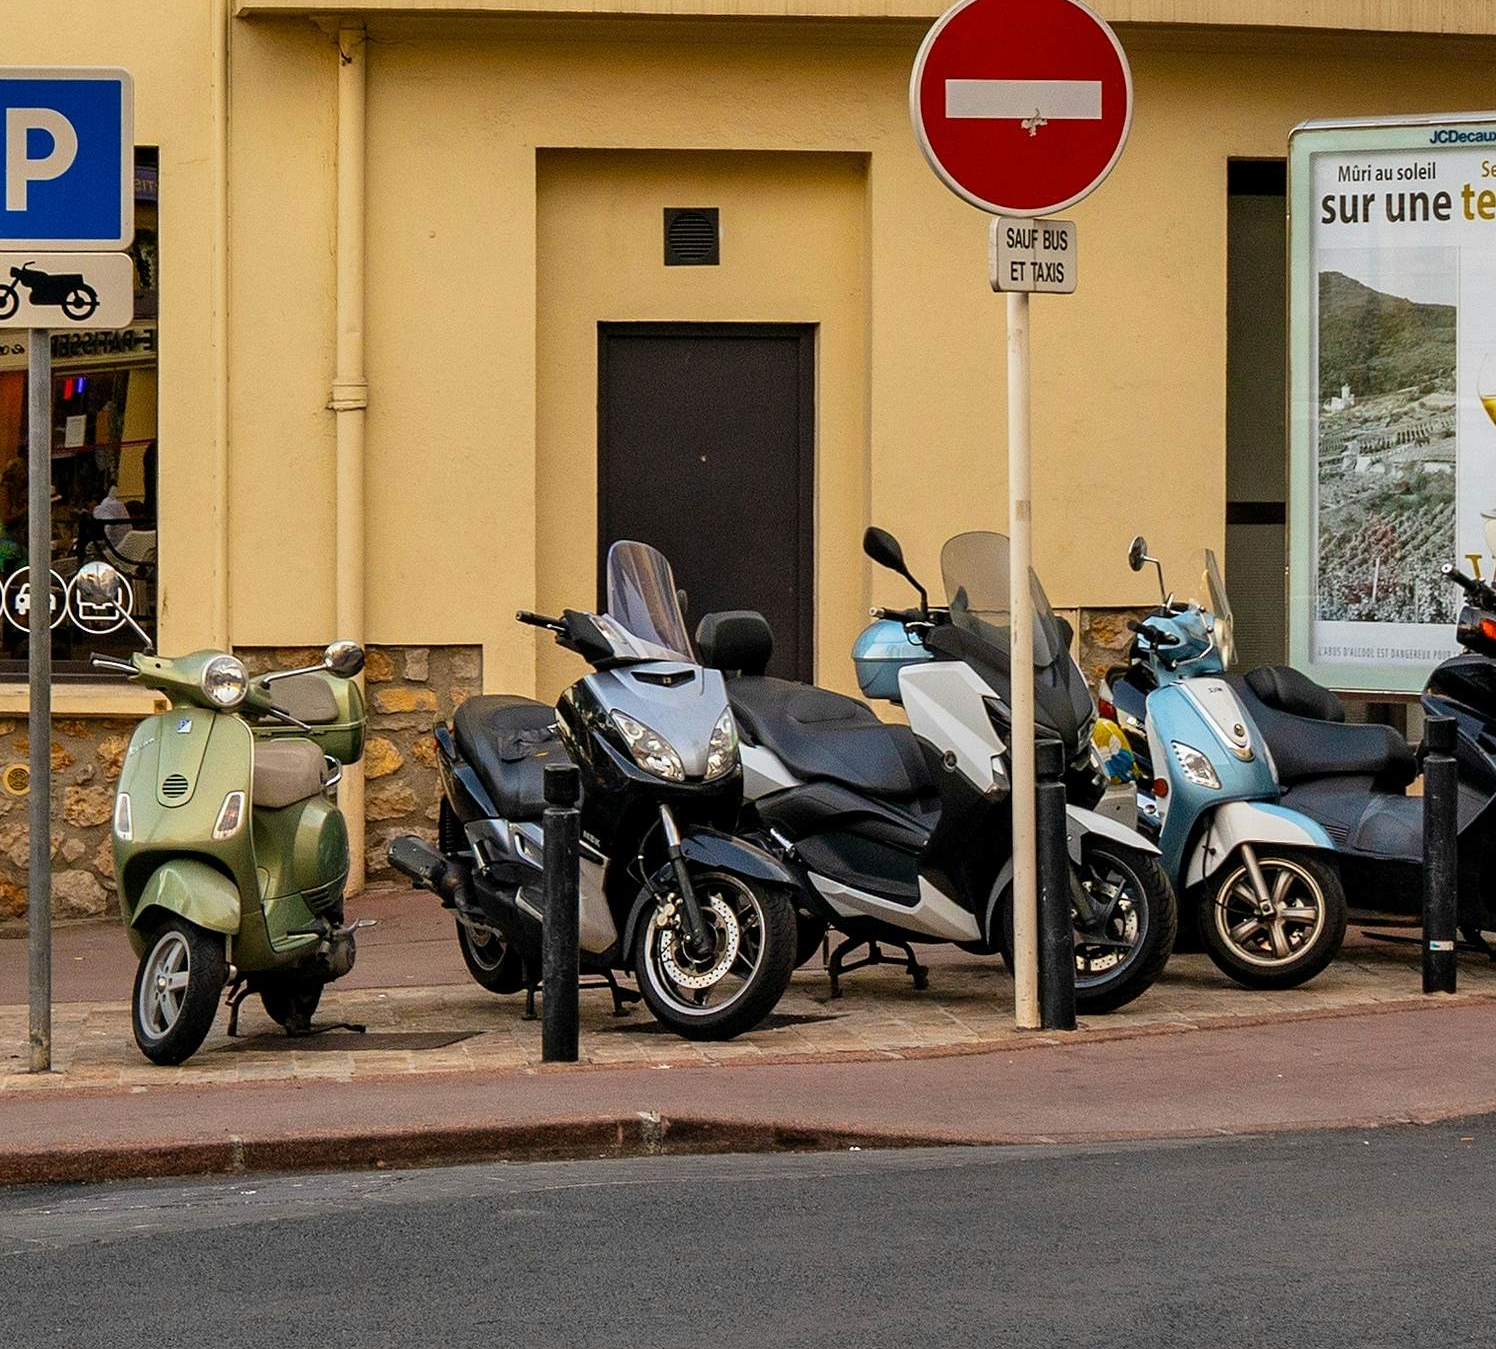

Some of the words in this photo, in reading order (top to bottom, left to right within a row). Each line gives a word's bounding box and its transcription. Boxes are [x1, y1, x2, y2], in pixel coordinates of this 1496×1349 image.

[5, 107, 78, 212] P
[1338, 164, 1371, 183] Mûri
[1375, 167, 1393, 181] au
[1397, 162, 1436, 181] soleil
[1321, 183, 1375, 224] sur
[1385, 180, 1452, 222] une
[1006, 228, 1038, 249] SAUF
[1043, 229, 1068, 251] BUS
[1010, 261, 1025, 282] ET
[1030, 261, 1065, 284] TAXIS
[1376, 647, 1389, 658] EST
[1391, 648, 1431, 659] DANGEREUX
